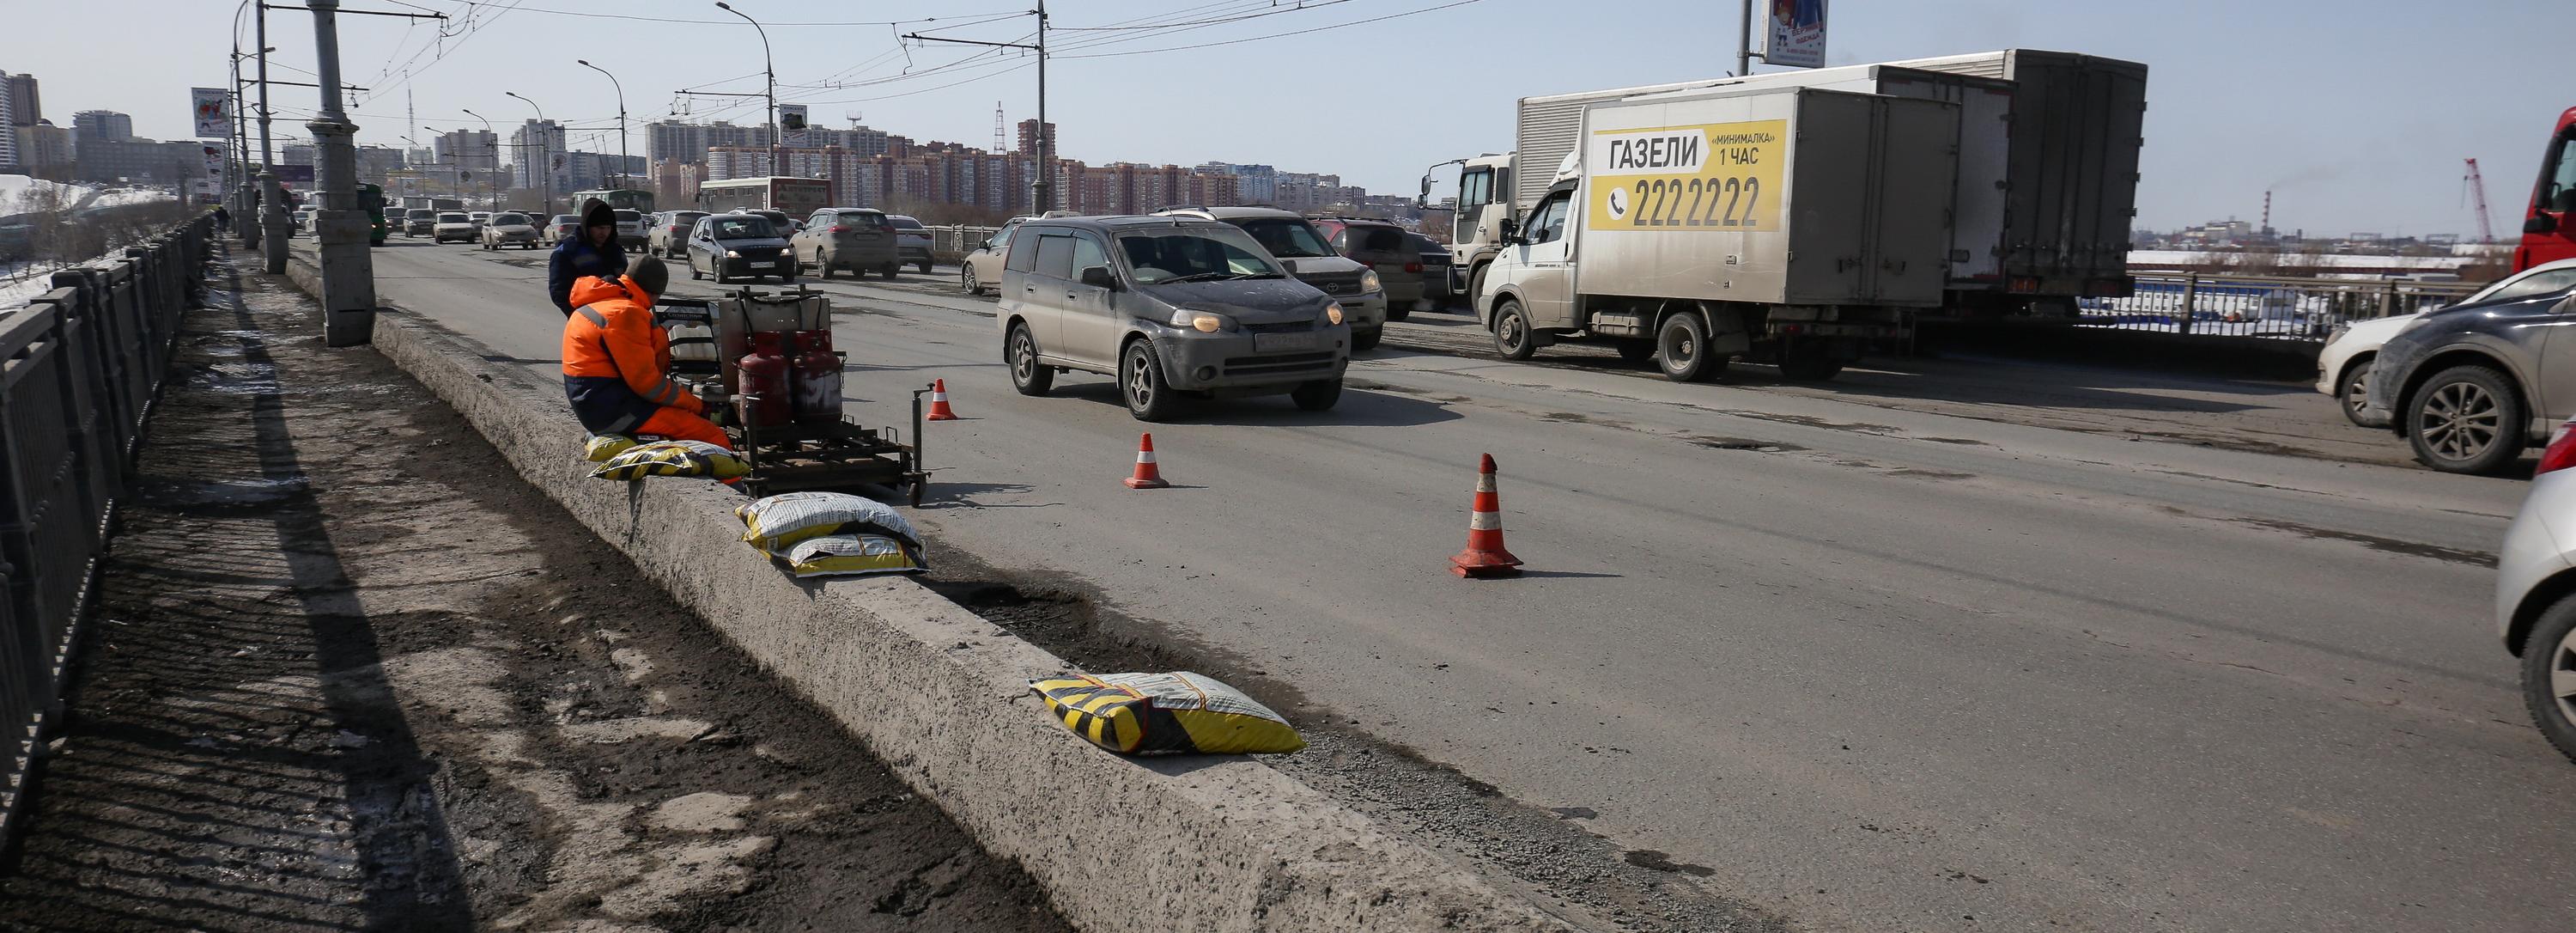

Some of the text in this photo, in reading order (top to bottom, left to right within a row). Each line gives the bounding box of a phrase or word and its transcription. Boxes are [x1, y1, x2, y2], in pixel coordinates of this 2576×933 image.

[1711, 132, 1776, 145] «МИНИМАЛКА»
[1609, 136, 1698, 169] ГАЗЕЛИ
[1719, 147, 1759, 166] 1 ЧАС
